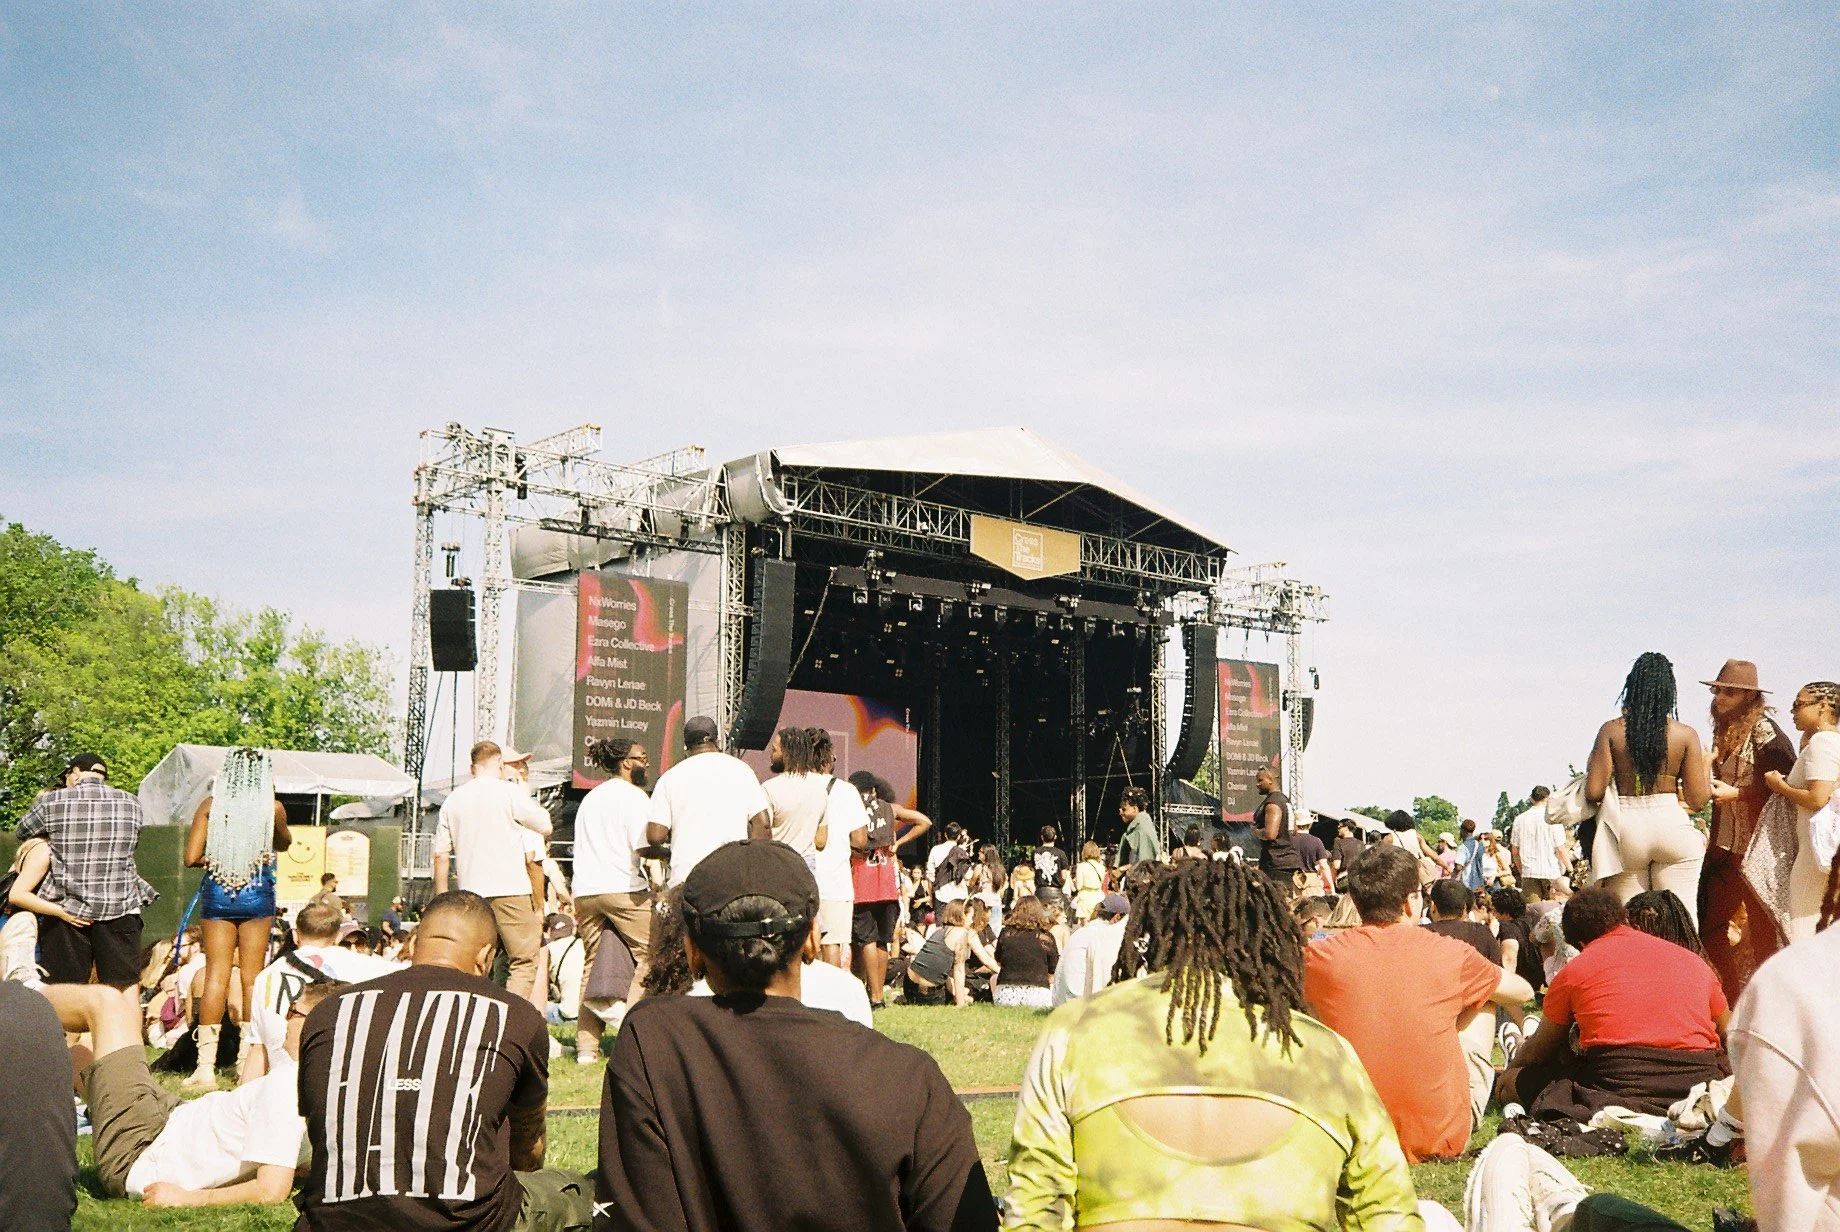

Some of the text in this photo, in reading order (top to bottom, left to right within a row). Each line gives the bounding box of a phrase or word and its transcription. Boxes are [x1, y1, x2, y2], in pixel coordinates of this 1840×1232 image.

[588, 616, 626, 631] Masego
[610, 637, 655, 652] Collective
[607, 657, 628, 669] Mist
[586, 675, 616, 690] Ravyn
[586, 696, 662, 712] DOMi & JD Beck
[585, 715, 648, 732] Yazmin Lacey
[386, 1078, 423, 1091] LESS
[322, 990, 509, 1203] HATE
